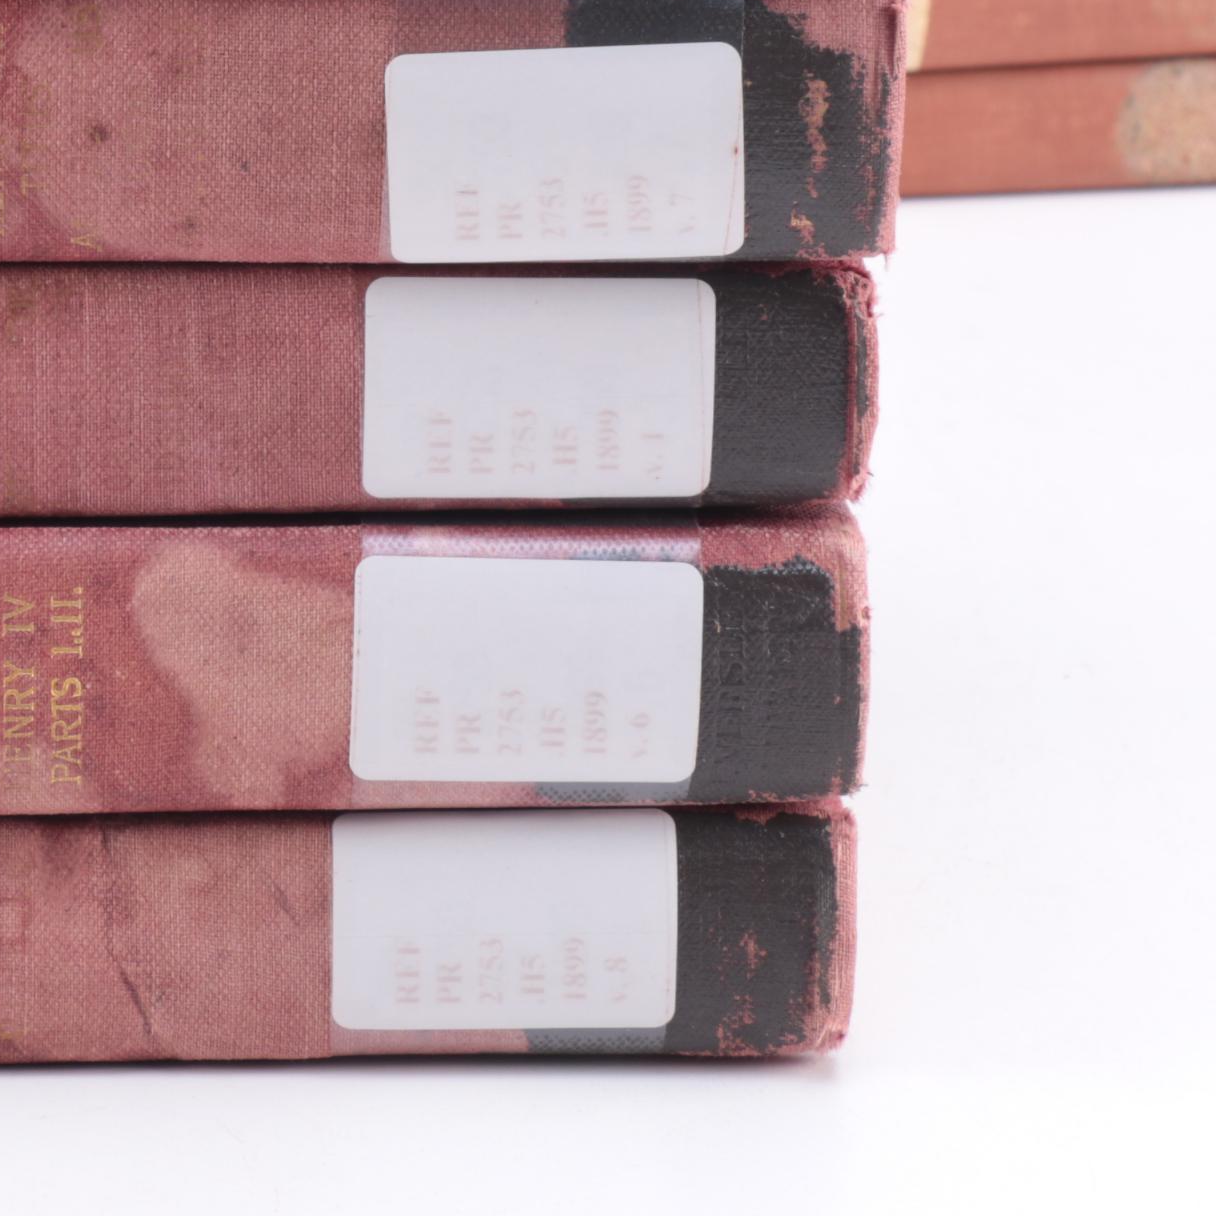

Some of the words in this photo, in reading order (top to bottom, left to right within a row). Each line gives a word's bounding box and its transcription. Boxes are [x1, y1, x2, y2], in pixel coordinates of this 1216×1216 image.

[496, 200, 524, 241] PR
[536, 175, 568, 240] 2753
[623, 174, 652, 233] 1899
[667, 191, 696, 208] 7
[467, 432, 495, 476] PR
[510, 407, 537, 476] 2753
[594, 406, 621, 472] 1899
[0, 592, 36, 638] IV
[49, 676, 83, 786] PARTS
[454, 711, 481, 755] PR
[496, 688, 526, 756] 2753
[579, 688, 609, 755] 1899
[624, 710, 652, 731] 6
[434, 960, 464, 1006] PR
[475, 933, 504, 1005] 2753
[558, 935, 587, 1001] 1899
[602, 955, 628, 974] 8
